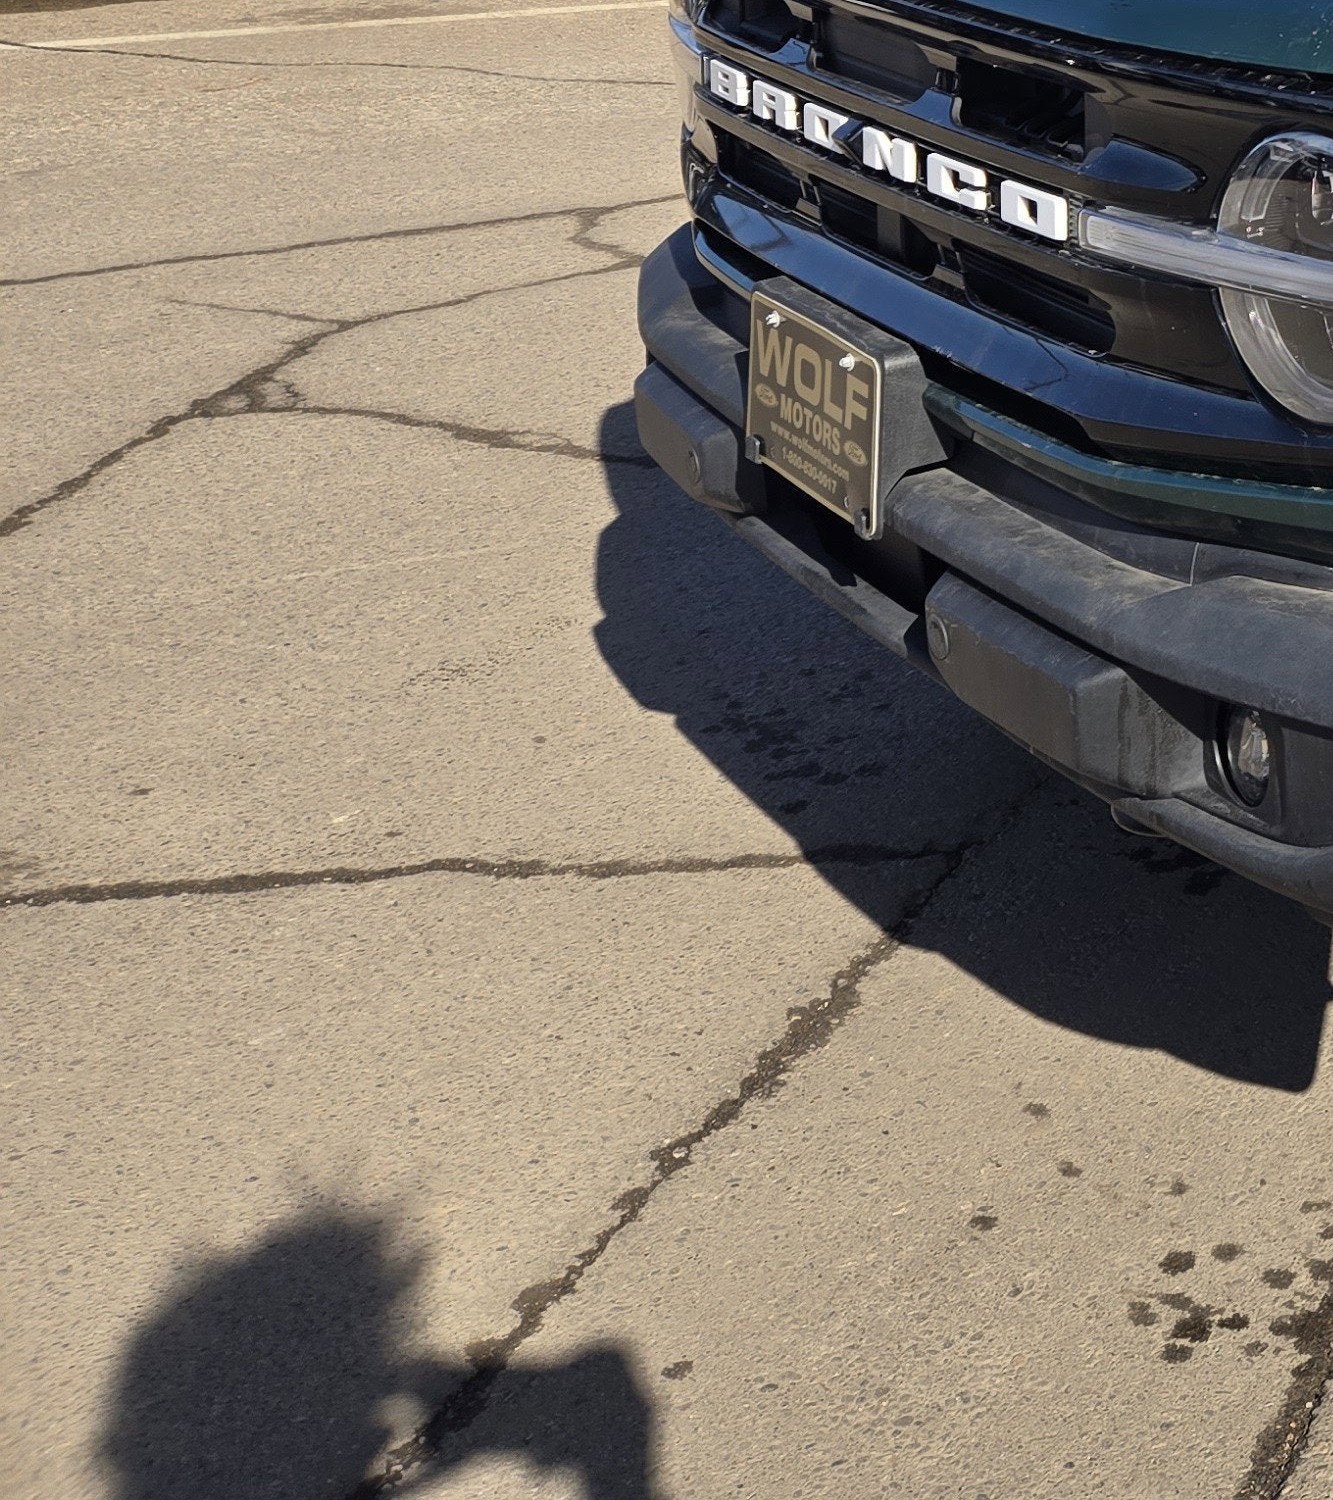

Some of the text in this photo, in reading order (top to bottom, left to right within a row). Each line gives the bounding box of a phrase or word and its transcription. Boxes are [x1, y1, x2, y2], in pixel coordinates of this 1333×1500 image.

[706, 56, 1068, 241] BRONCO
[756, 318, 869, 430] WOLF
[770, 421, 850, 482] www.wolfmotors.com
[780, 393, 841, 456] MOTORS
